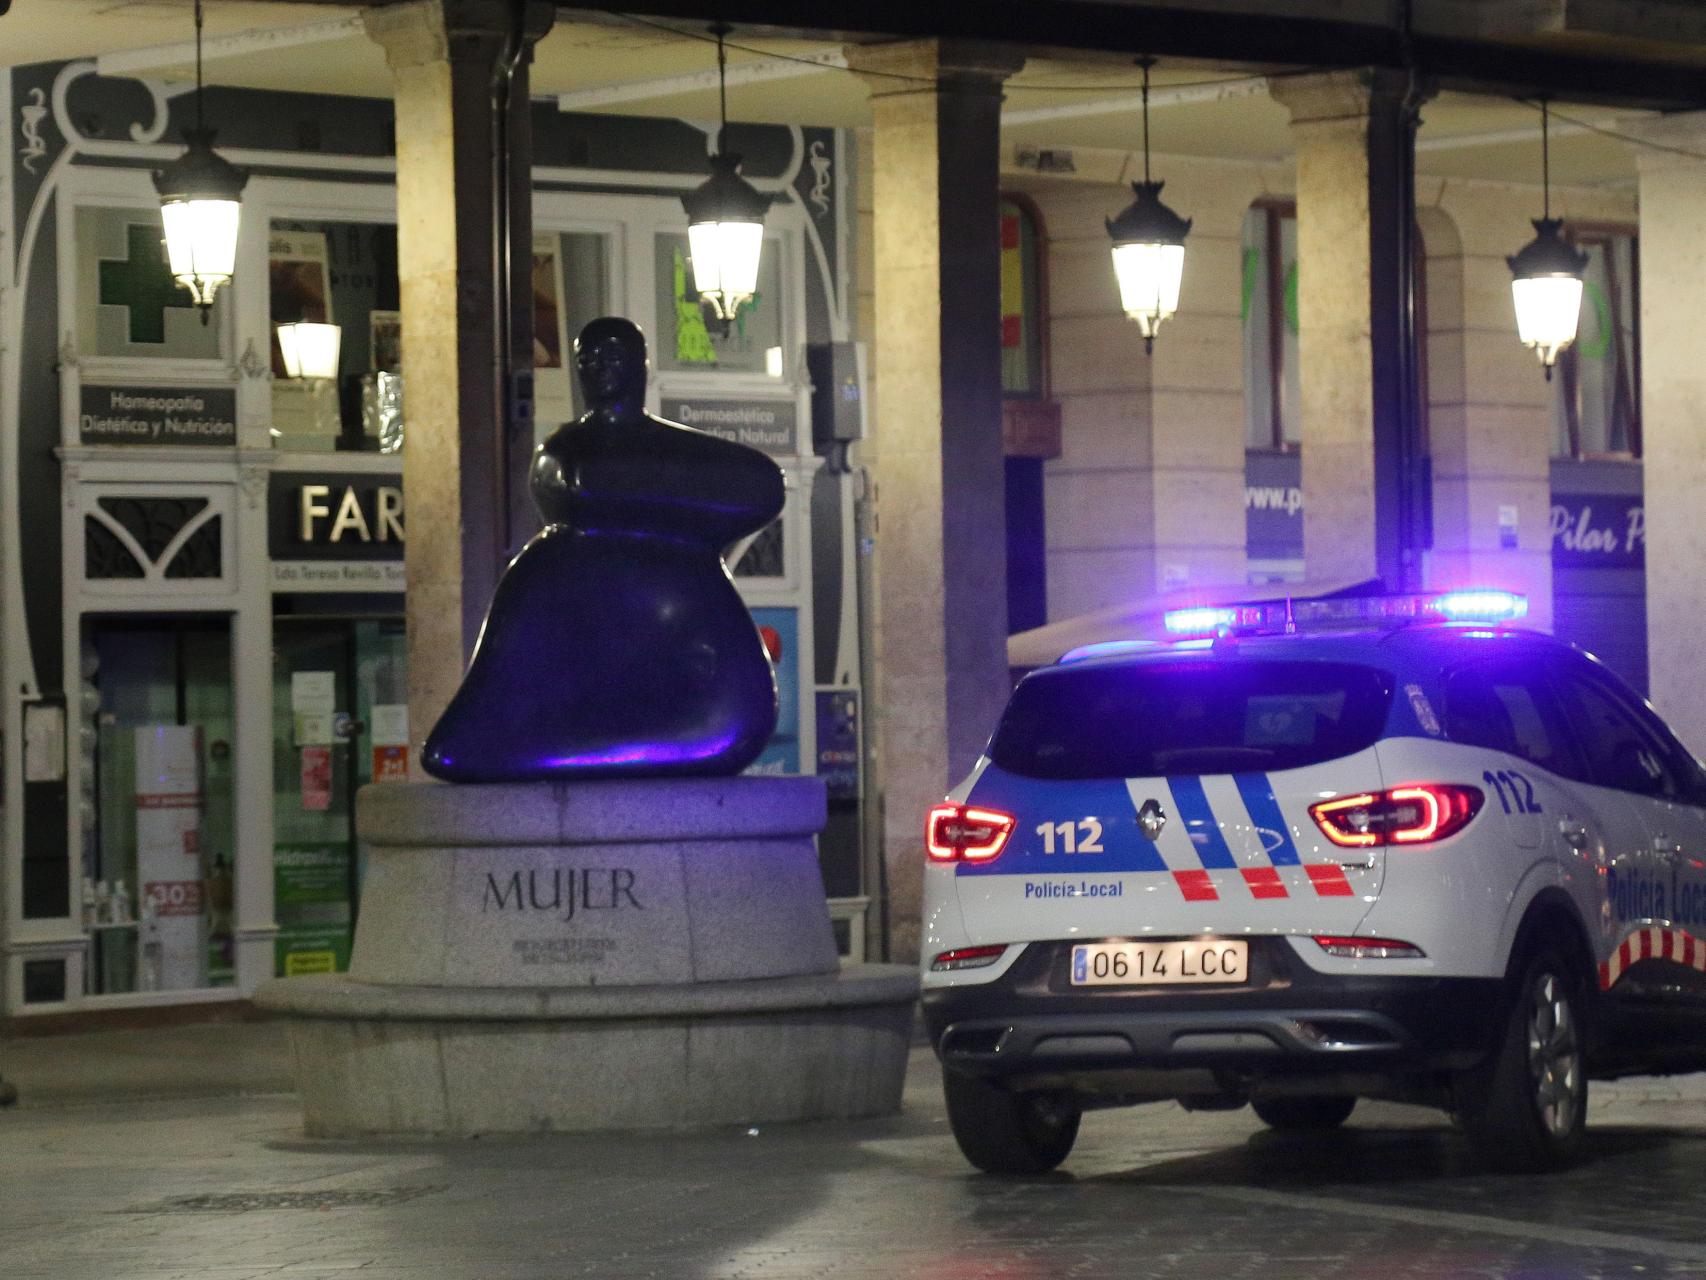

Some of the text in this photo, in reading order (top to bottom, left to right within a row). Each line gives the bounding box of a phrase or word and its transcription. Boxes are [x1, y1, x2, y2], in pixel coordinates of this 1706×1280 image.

[152, 421, 162, 439] y
[301, 485, 405, 542] FAR
[1550, 505, 1644, 553] Pilar P
[1483, 770, 1543, 815] 112
[1036, 820, 1104, 854] 112
[483, 868, 644, 923] MUJER
[1025, 880, 1123, 898] Policía Local
[1093, 950, 1168, 978] 0614
[1180, 949, 1237, 976] LCC
